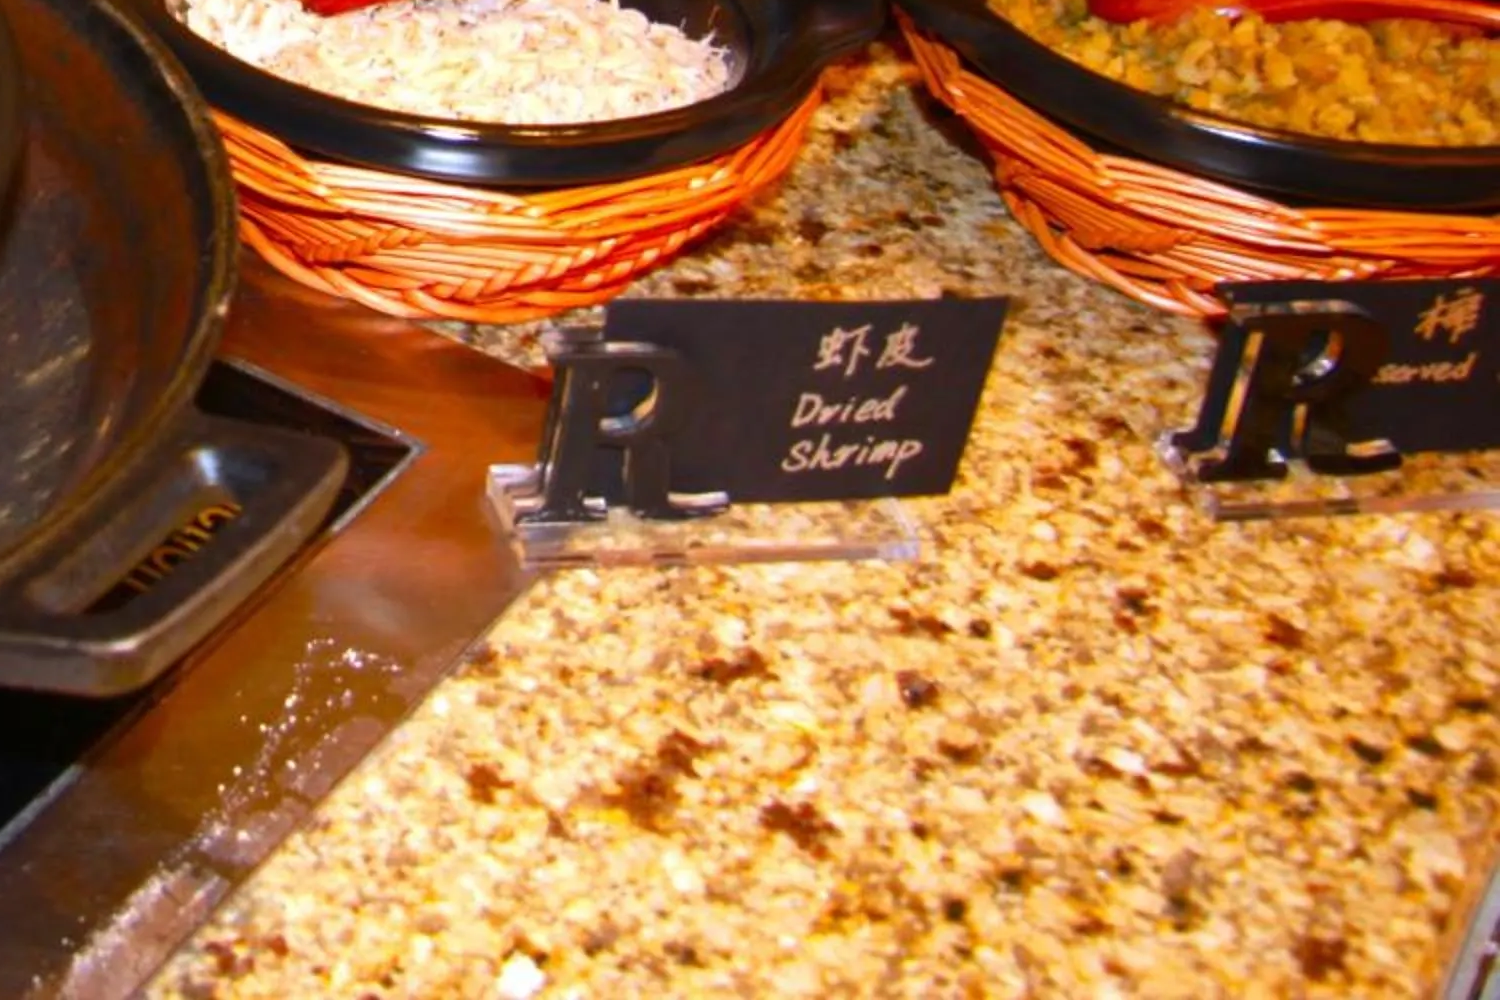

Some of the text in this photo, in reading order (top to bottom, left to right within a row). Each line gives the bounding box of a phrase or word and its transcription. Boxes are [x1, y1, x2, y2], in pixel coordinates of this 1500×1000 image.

[812, 323, 934, 378] 虾皮
[512, 327, 730, 524] R
[790, 385, 908, 428] Dried
